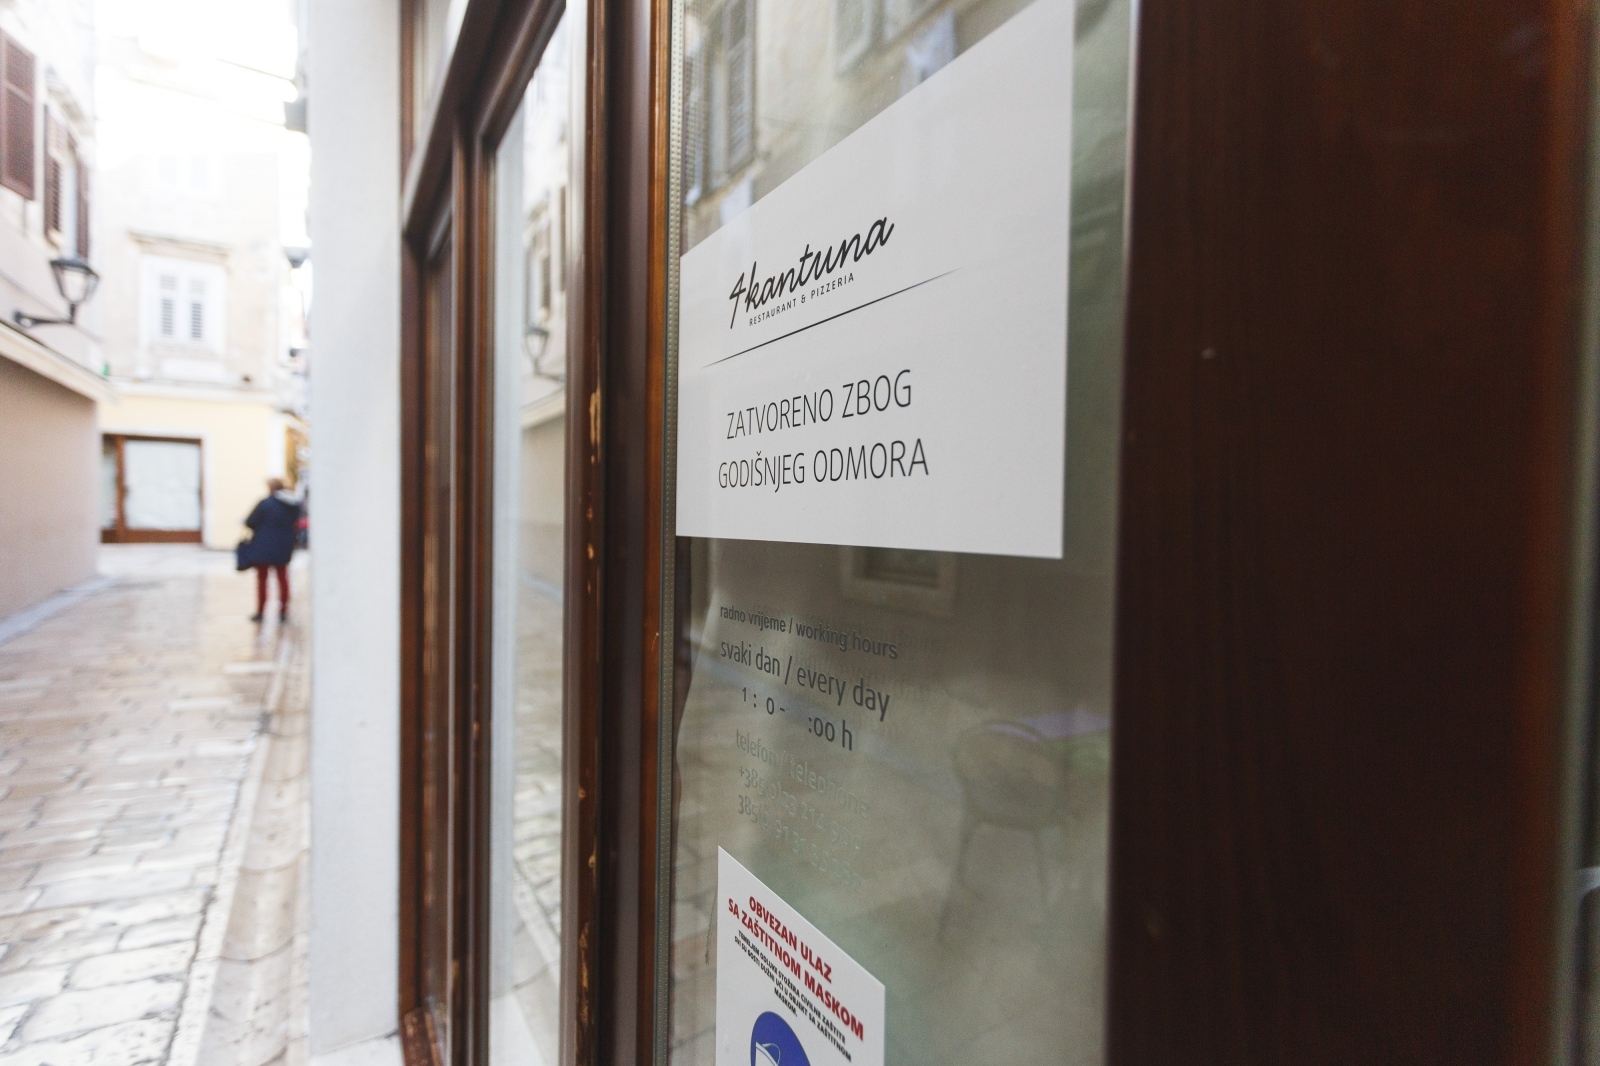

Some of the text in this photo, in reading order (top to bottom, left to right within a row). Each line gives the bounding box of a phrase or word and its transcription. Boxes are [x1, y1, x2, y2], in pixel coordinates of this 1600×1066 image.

[749, 272, 855, 327] RESTAURANT & PIZZERIA
[727, 369, 912, 440] ZATVORENO ZBOG
[718, 438, 929, 493] GODIŠNJEG ODMORA
[720, 605, 746, 623] radno
[748, 611, 786, 632] vrijeme
[795, 622, 848, 652] working
[852, 630, 898, 660] hours
[721, 641, 752, 667] svaki
[755, 647, 780, 677] dan
[797, 666, 847, 706] every
[852, 677, 891, 722] day
[736, 729, 777, 768] telefon
[841, 719, 853, 751] h
[749, 896, 832, 984] OBVEZAN ULAZ
[728, 898, 864, 1042] SA ZAŠTITNOM MASKOM
[801, 993, 822, 1019] CIVILNE
[808, 1012, 816, 1025] SA
